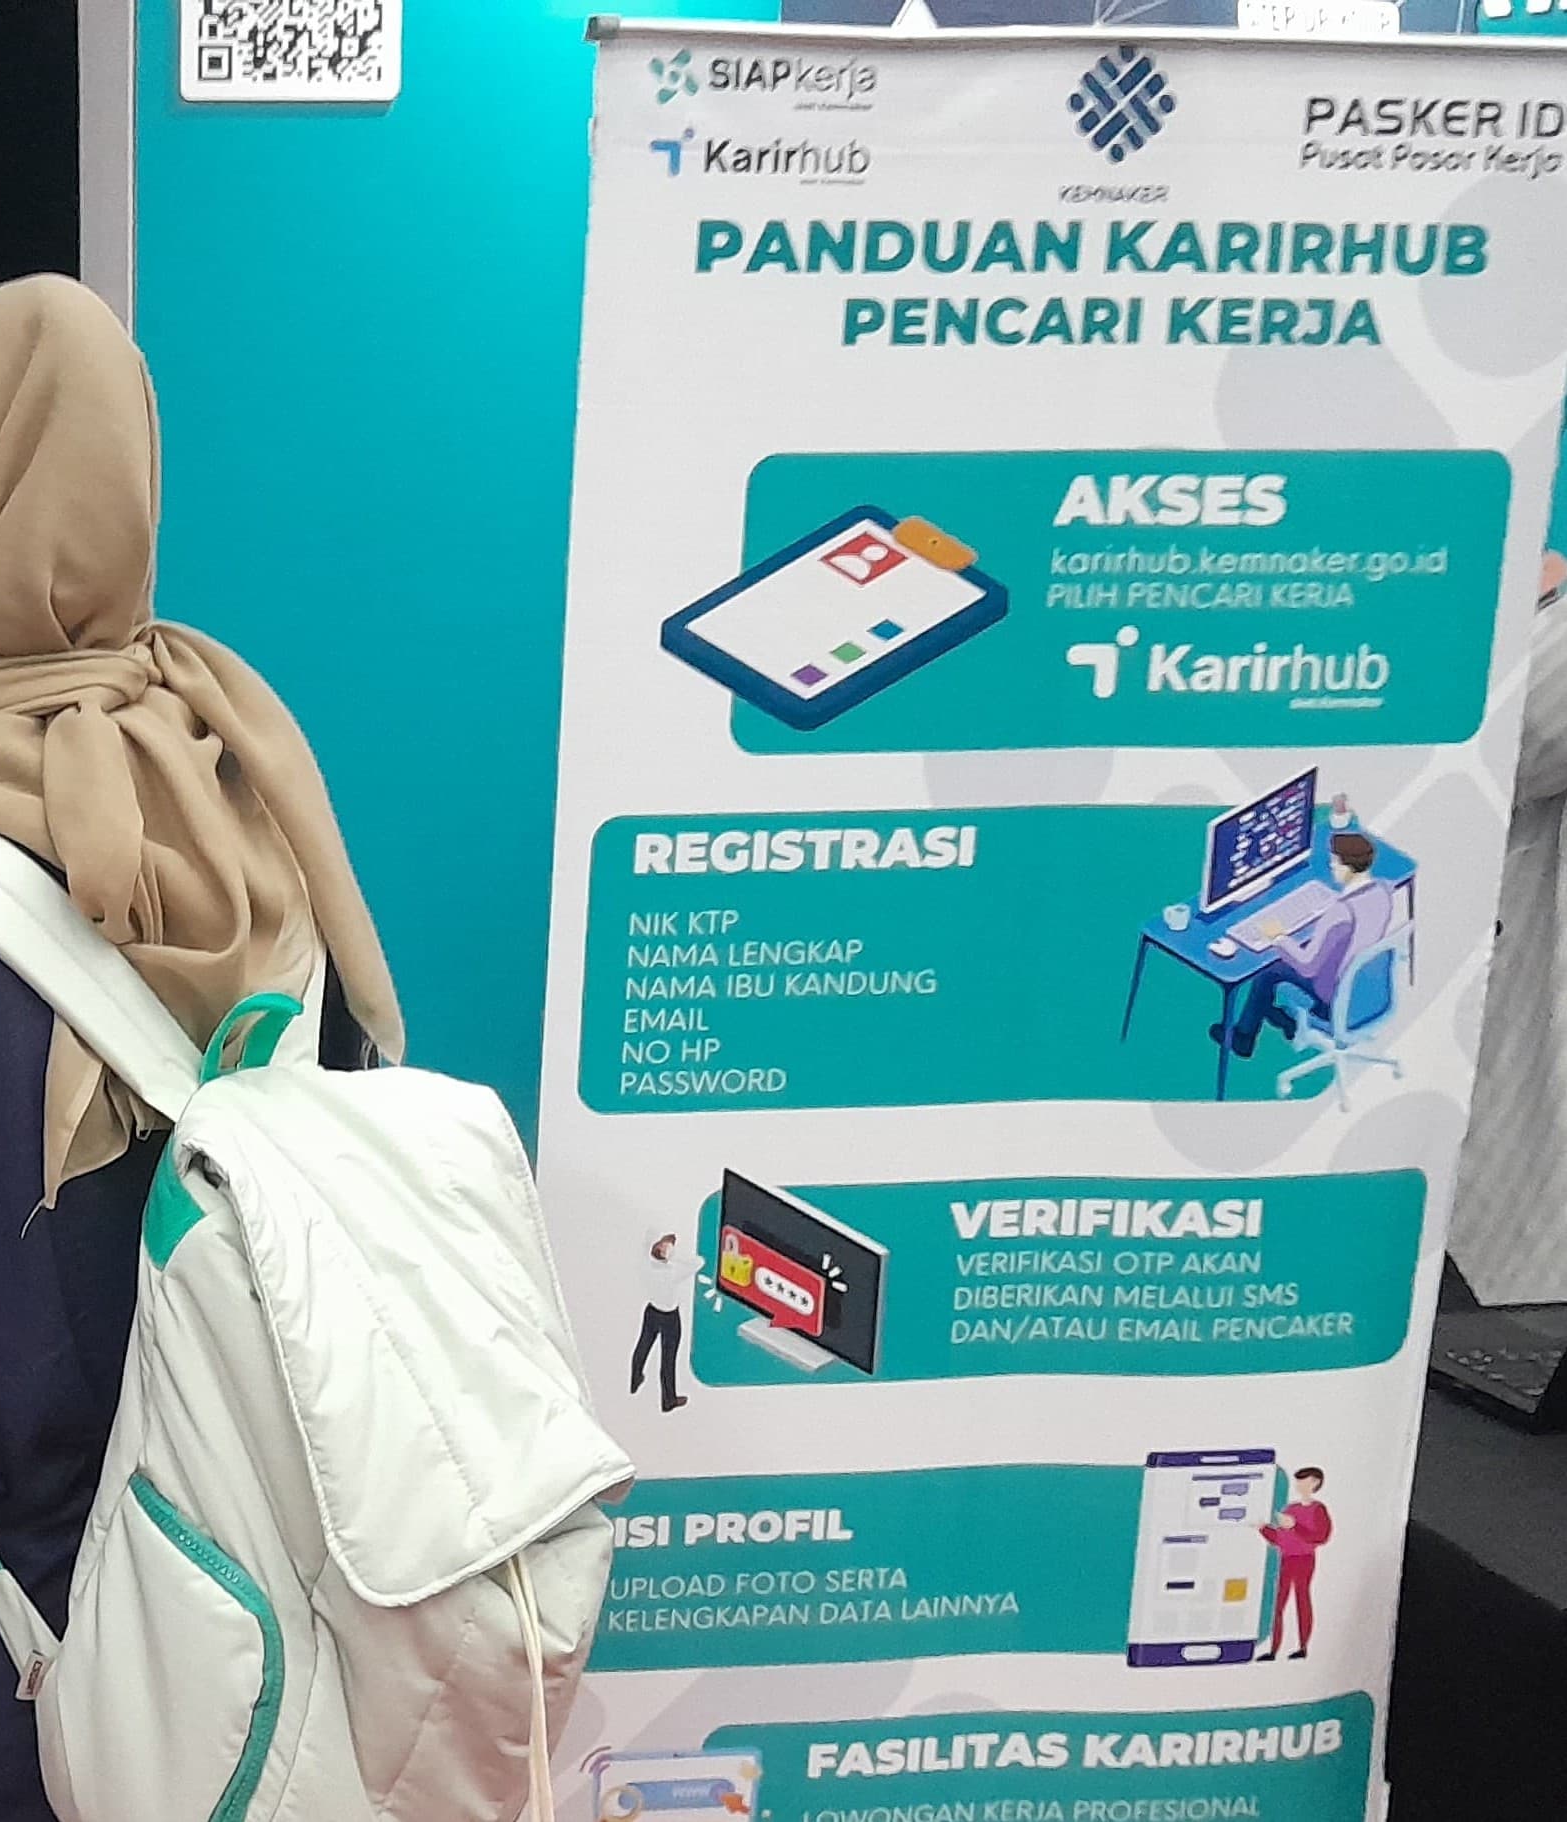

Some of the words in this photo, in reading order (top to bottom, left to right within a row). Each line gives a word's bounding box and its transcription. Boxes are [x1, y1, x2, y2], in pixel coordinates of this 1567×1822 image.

[709, 56, 877, 101] SIAPkerja
[1303, 97, 1504, 138] PASKER
[1517, 100, 1565, 138] ID
[703, 138, 871, 174] Karirhub
[695, 220, 1083, 274] PANDUAN
[1105, 220, 1491, 277] KARIRHUB
[842, 296, 1141, 346] PENCARI
[1165, 296, 1381, 347] KERJA
[1052, 474, 1288, 527] AKSES
[1049, 544, 1448, 581] karirhub.kemnaker.go.id
[1045, 582, 1118, 609] PILIH
[1126, 582, 1263, 609] PENCARI
[1270, 582, 1355, 608] KERJA
[1146, 641, 1390, 692] Karirhub
[633, 826, 978, 875] REGISTRASI
[629, 911, 679, 936] NIK
[687, 910, 740, 935] KTP
[627, 943, 719, 968] NAMA
[728, 939, 863, 967] LENGKAP
[625, 975, 716, 1000] NAMA
[726, 973, 775, 998] IBU
[784, 969, 937, 997] KANDUNG
[623, 1007, 709, 1033] EMAIL
[621, 1040, 670, 1065] NO
[681, 1038, 721, 1063] HP
[619, 1068, 787, 1096] PASSWORD
[950, 1198, 1263, 1240] VERIFIKASI
[956, 1251, 1103, 1277] VERIFIKASI
[1113, 1252, 1175, 1275] OTP
[1181, 1250, 1262, 1274] AKAN
[953, 1284, 1103, 1310] DIBERIKAN
[1113, 1285, 1232, 1309] MELALUI
[1244, 1283, 1299, 1307] SMS
[950, 1316, 1106, 1344] DAN/ATAU
[1117, 1317, 1202, 1342] EMAIL
[1213, 1313, 1354, 1341] PENCAKER
[613, 1515, 670, 1548] ISI
[683, 1509, 853, 1546] PROFIL
[610, 1573, 725, 1600] UPLOAD
[735, 1570, 815, 1596] FOTO
[824, 1567, 908, 1593] SERTA
[608, 1603, 809, 1633] KELENGKAPAN
[819, 1598, 893, 1624] DATA
[901, 1591, 1020, 1621] LAINNYA
[806, 1731, 1070, 1779] FASILITAS
[1081, 1719, 1343, 1770] KARIRHUB
[803, 1802, 975, 1822] LOWONGAN
[983, 1800, 1064, 1822] KERJA
[1073, 1796, 1261, 1822] PROFESIONAL
